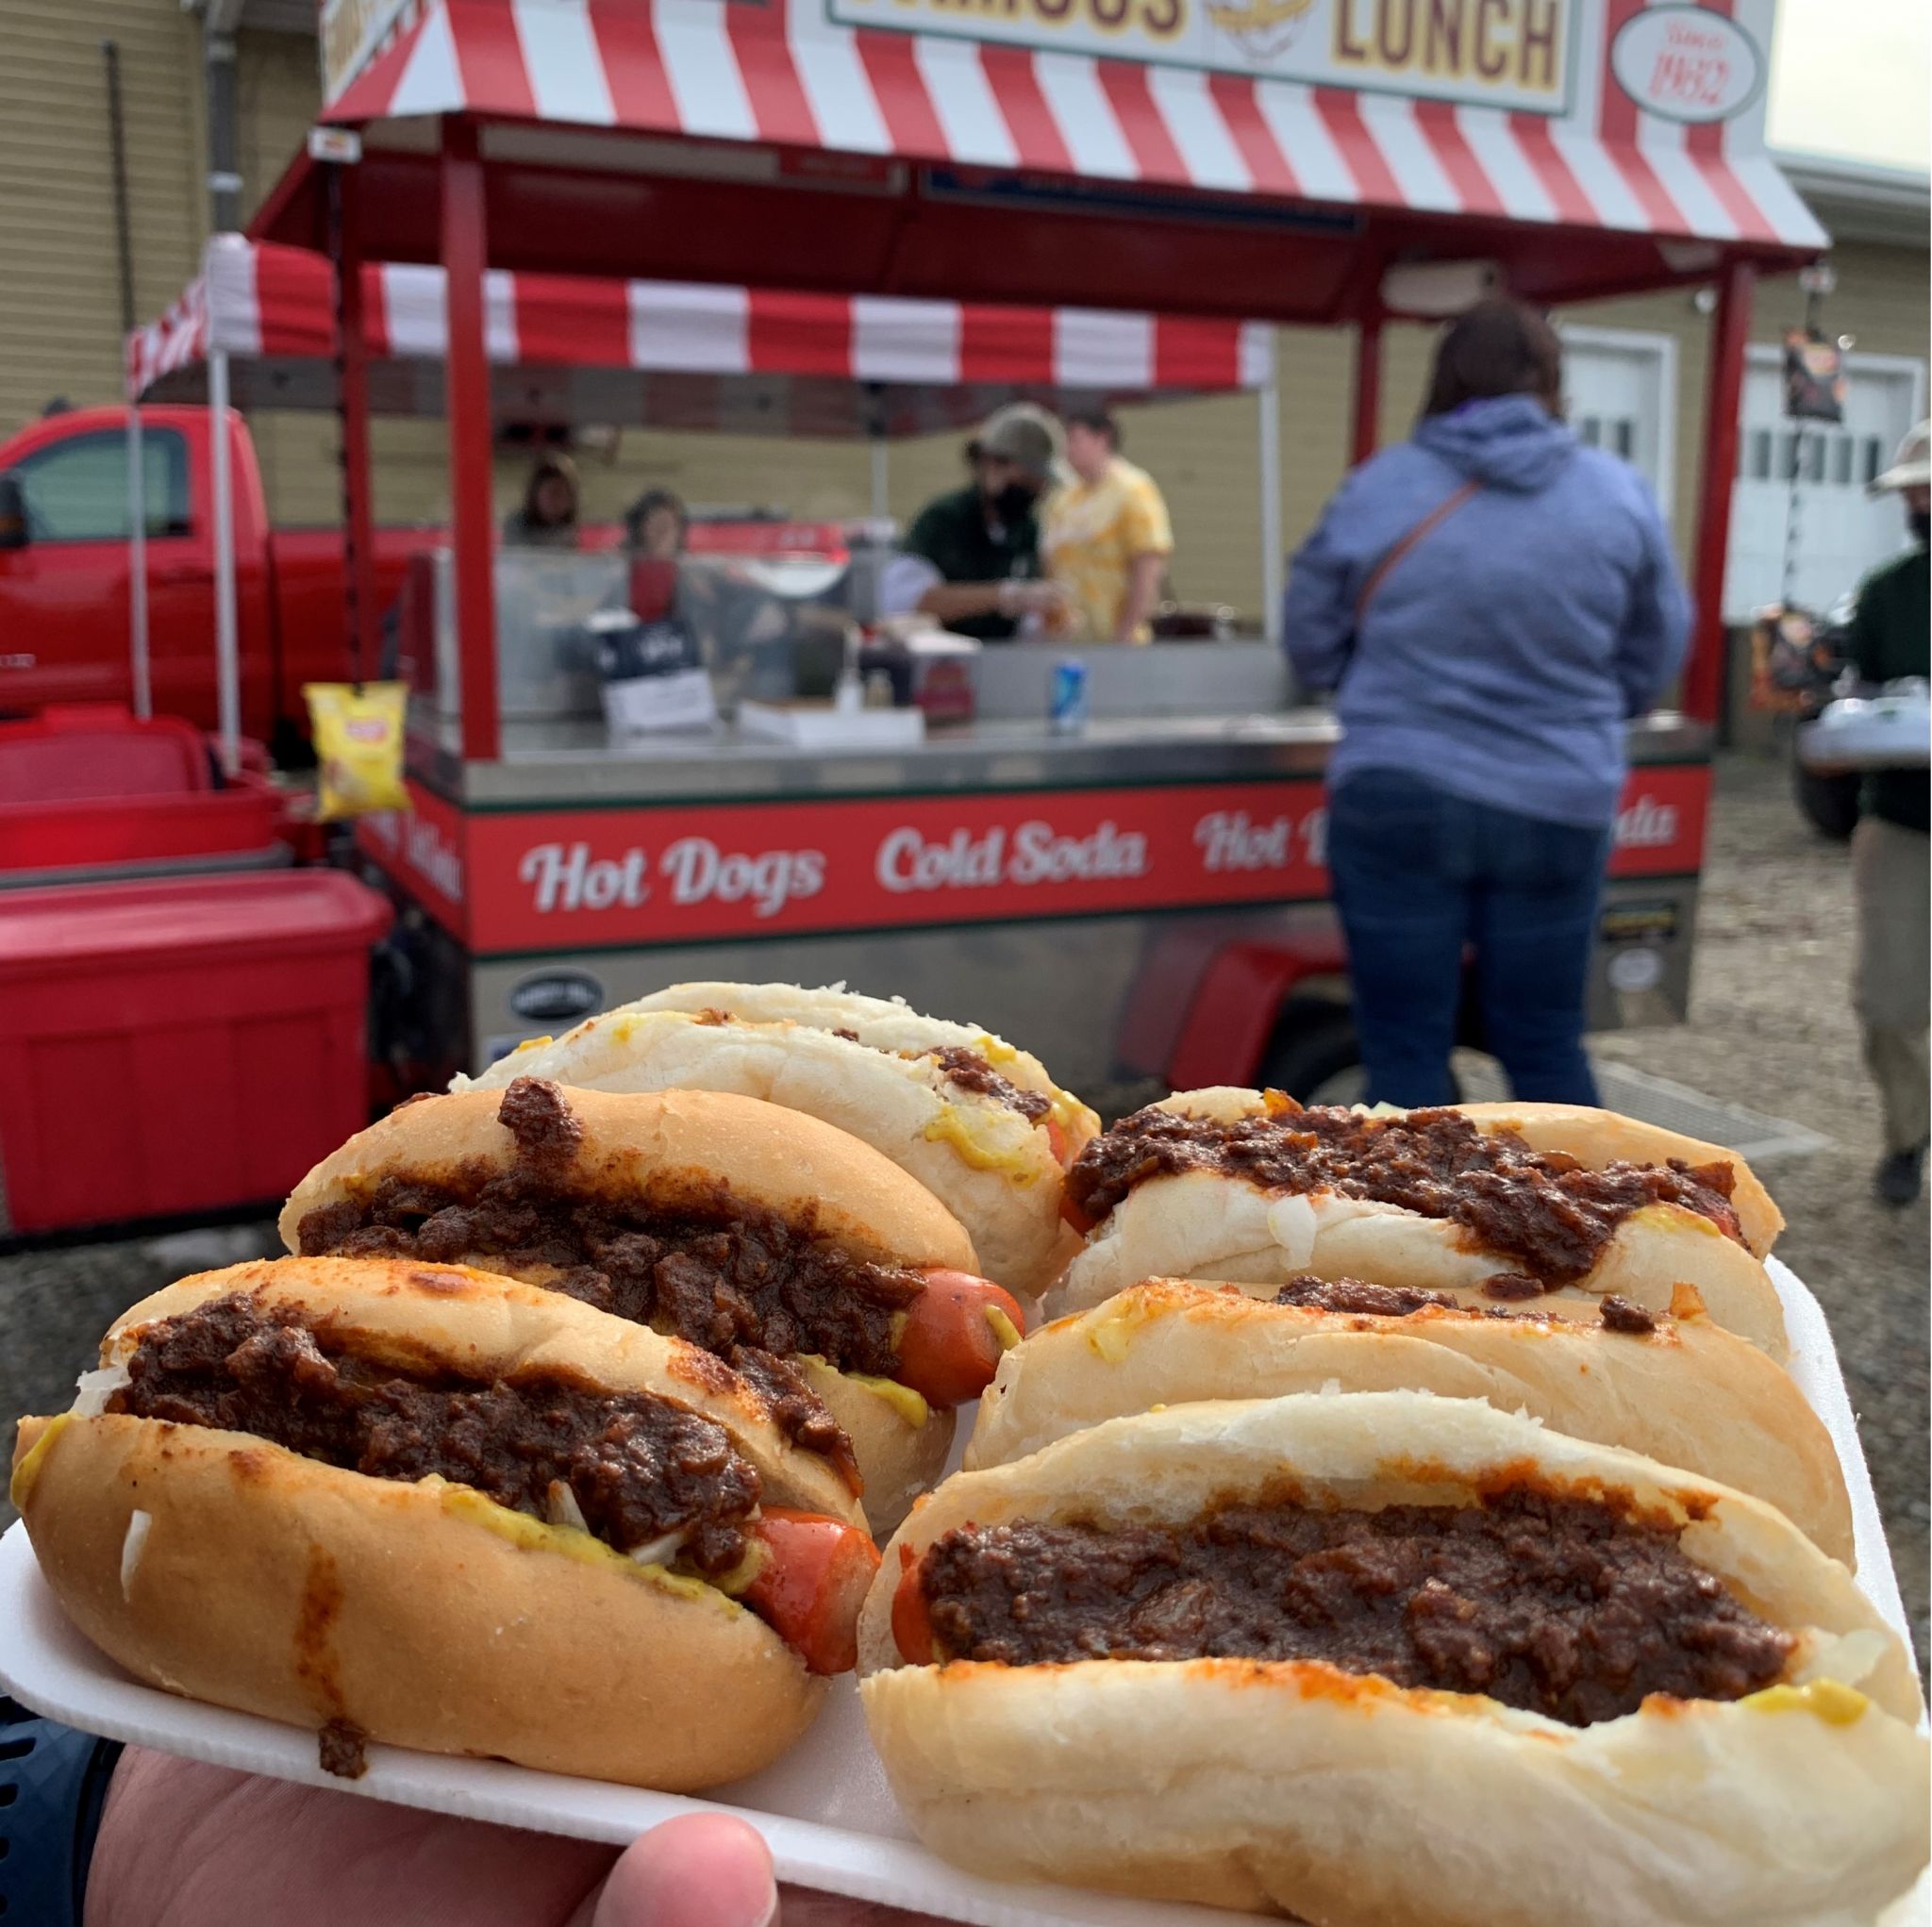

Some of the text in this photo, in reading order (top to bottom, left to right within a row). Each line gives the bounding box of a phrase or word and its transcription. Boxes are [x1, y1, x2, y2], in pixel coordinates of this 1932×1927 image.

[1326, 0, 1557, 91] LUNCH
[519, 841, 651, 913] Hot
[660, 836, 827, 918] Dogs
[875, 820, 1148, 891] Cold Soda
[1193, 810, 1291, 871] Hot
